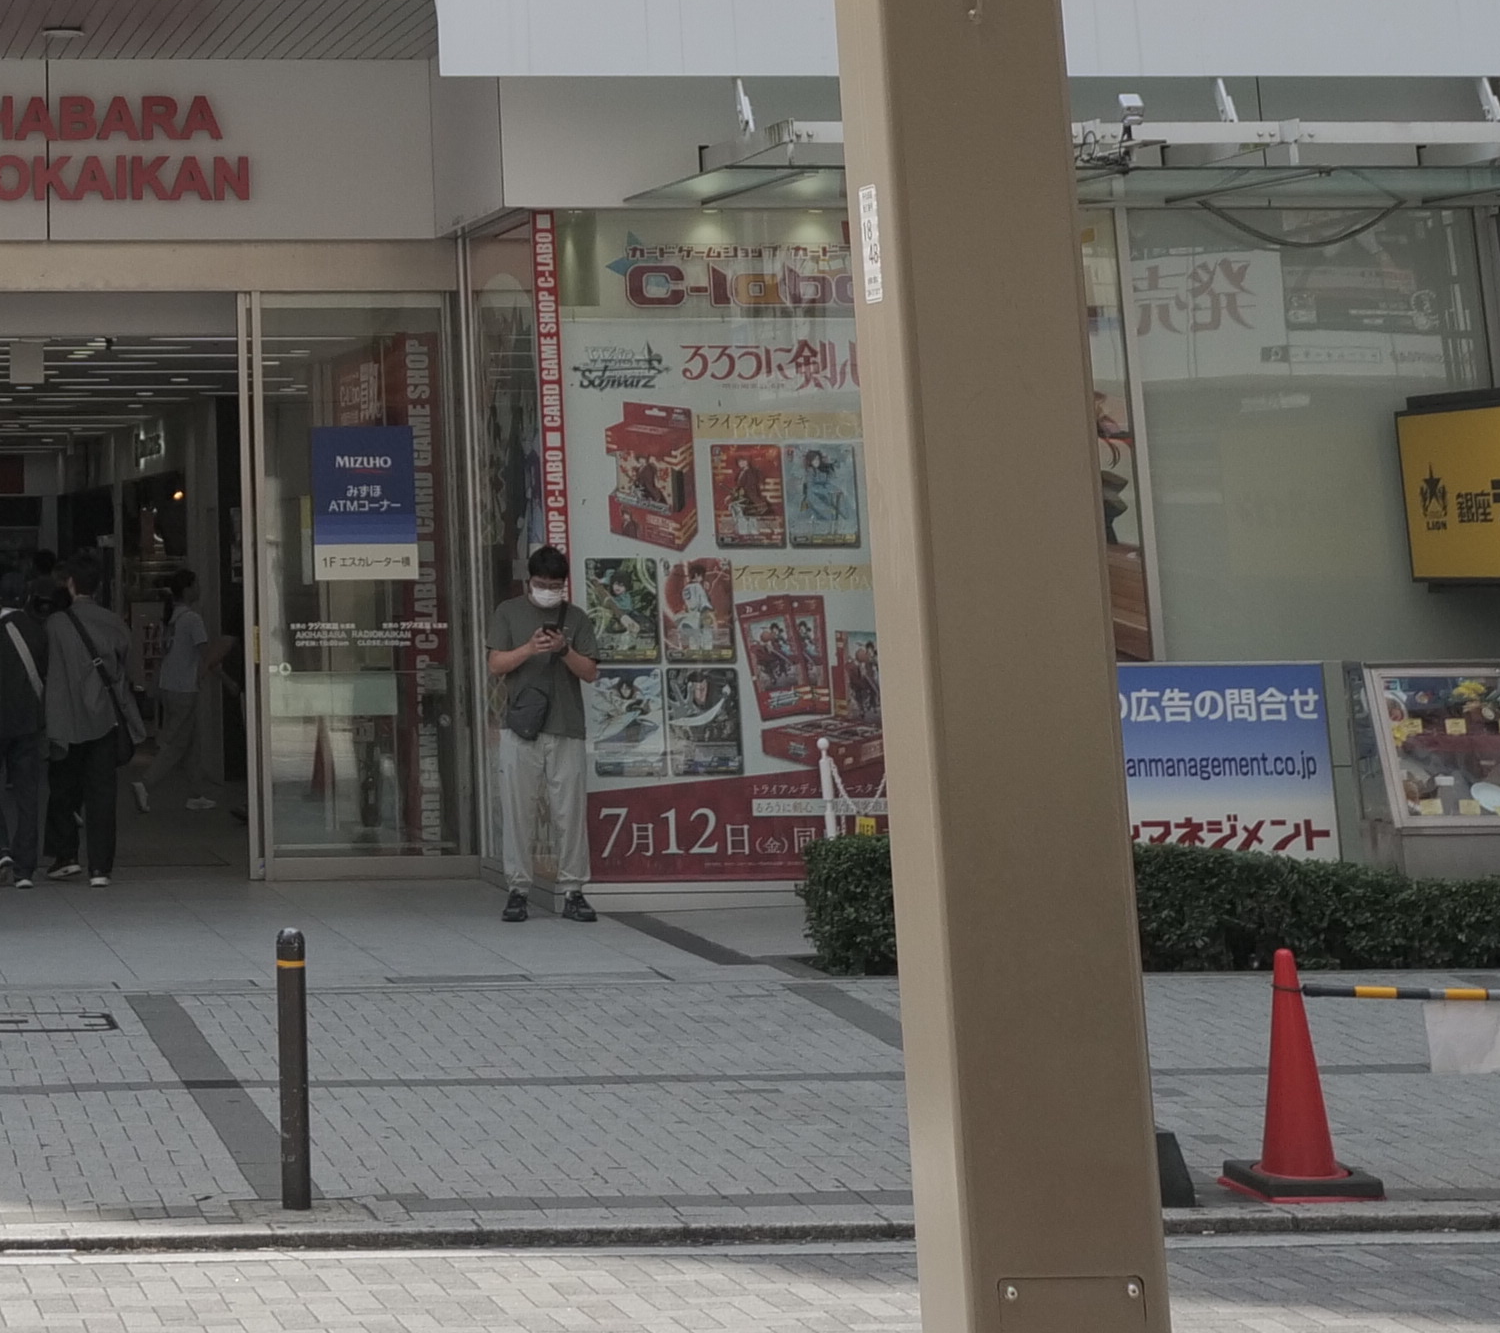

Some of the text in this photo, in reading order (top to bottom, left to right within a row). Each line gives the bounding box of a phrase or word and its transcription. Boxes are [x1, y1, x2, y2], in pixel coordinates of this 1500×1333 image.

[535, 231, 561, 428] CARD GAME SHOP C-LABO
[405, 338, 431, 400] SHOP
[695, 413, 811, 430] トライアルデッキ
[334, 455, 392, 470] MIZUHO
[545, 450, 565, 507] C-LABO
[345, 485, 383, 498] みずほ
[328, 499, 402, 513] ATMコーナー
[1425, 519, 1449, 531] LION
[322, 556, 336, 569] 1F
[733, 564, 858, 581] ブースターパック
[1118, 686, 1320, 723] 広告の問合せ
[1126, 750, 1318, 781] anmanagement.co.jp
